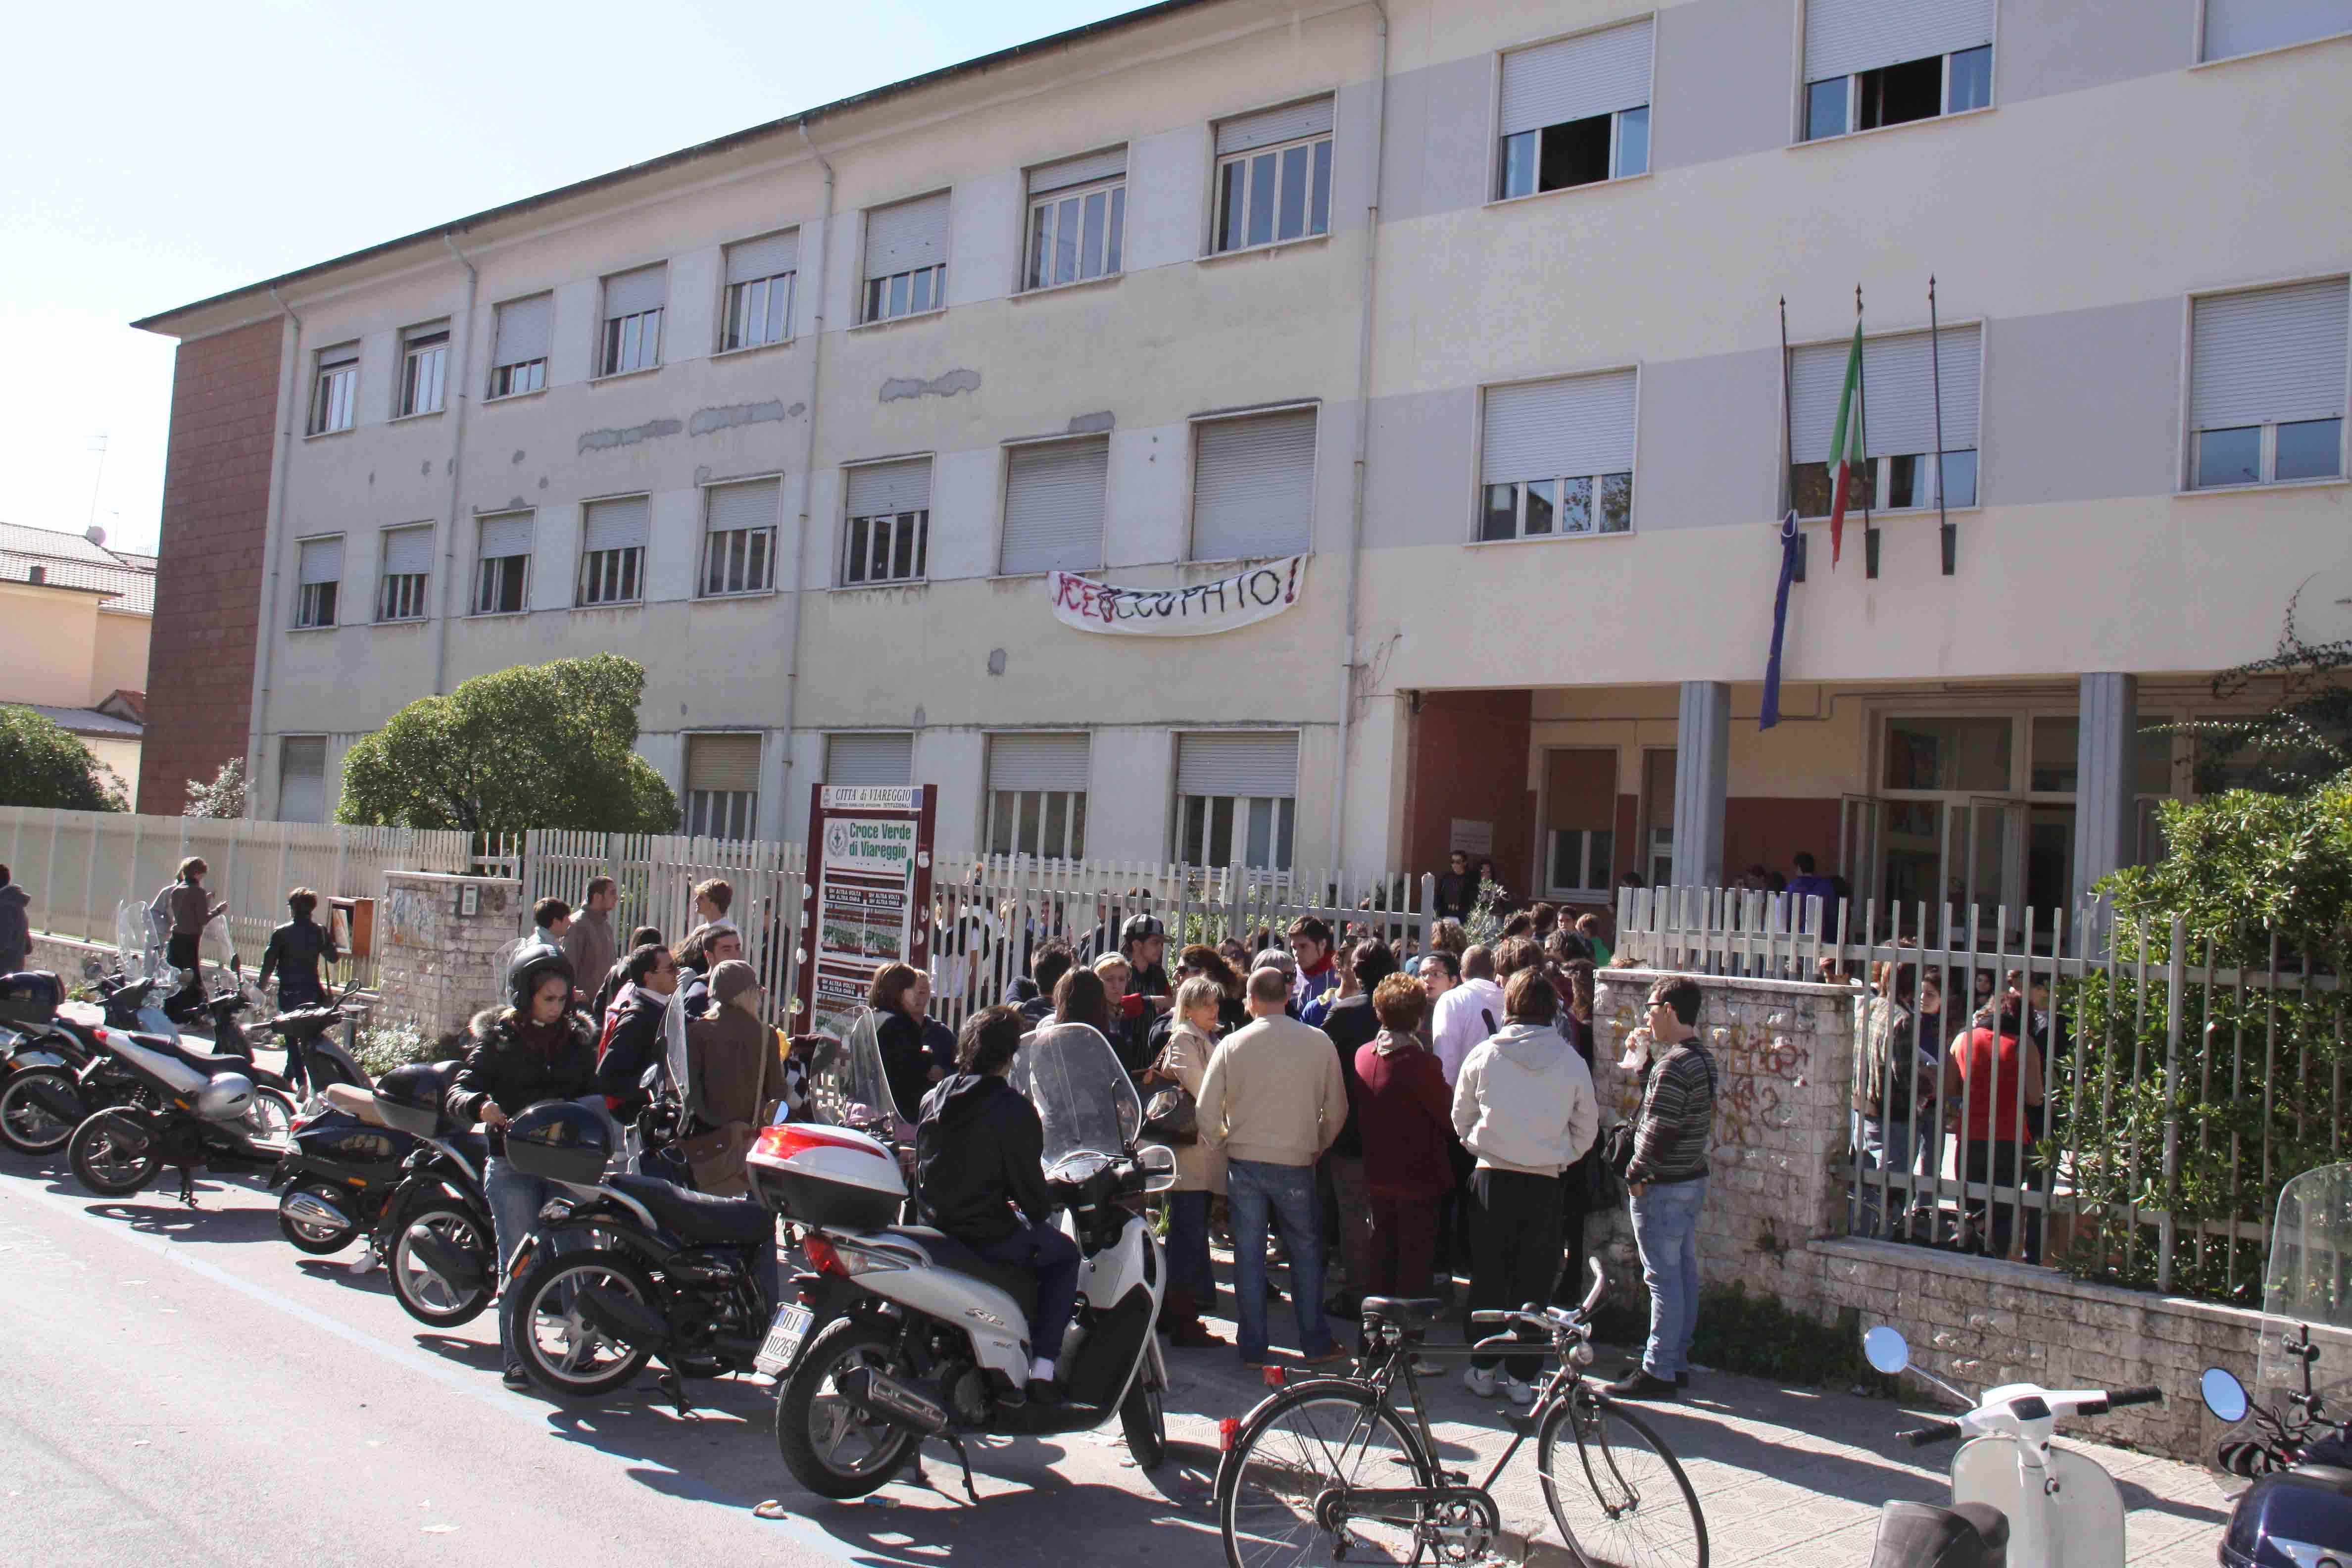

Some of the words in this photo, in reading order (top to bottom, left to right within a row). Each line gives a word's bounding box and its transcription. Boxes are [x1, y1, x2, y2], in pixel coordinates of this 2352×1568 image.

[860, 788, 866, 801] di
[869, 788, 911, 801] VIAREGGIO
[850, 822, 879, 839] Croce
[882, 823, 911, 840] Verde
[849, 840, 858, 856] di
[861, 841, 907, 861] Viareggio
[783, 1311, 800, 1330] DJ
[765, 1335, 798, 1359] 10269
